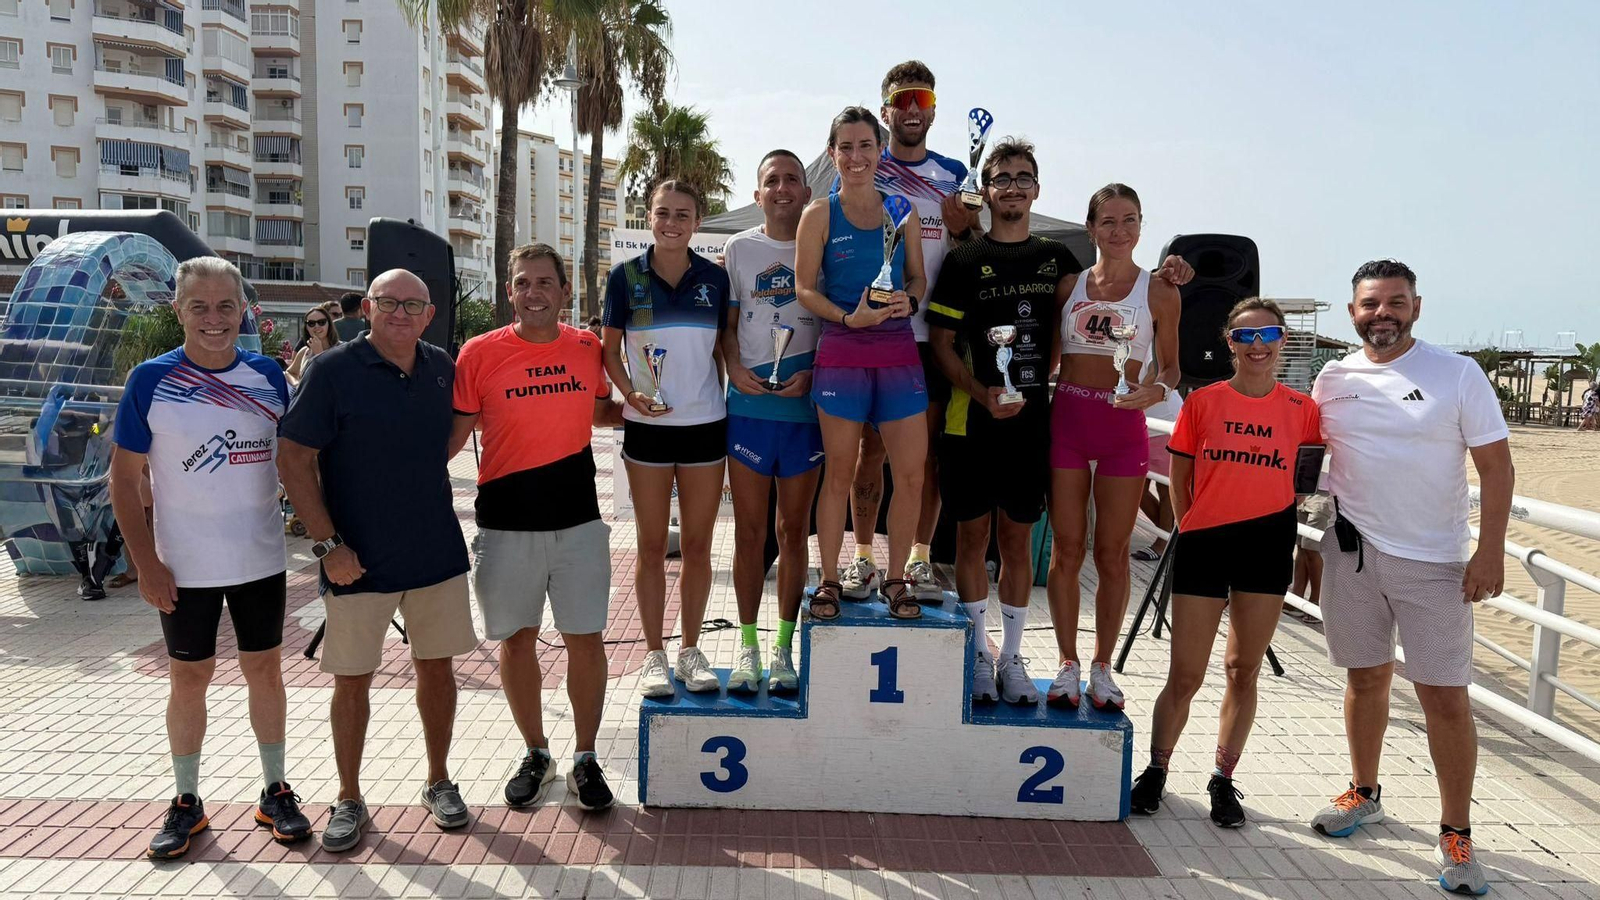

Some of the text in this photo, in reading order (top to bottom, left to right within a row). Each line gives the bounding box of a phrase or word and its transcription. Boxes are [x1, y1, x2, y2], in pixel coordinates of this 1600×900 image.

[919, 216, 942, 227] chip
[771, 276, 792, 288] 5K
[1003, 285, 1017, 296] LA
[1019, 283, 1055, 294] BARROS
[750, 288, 796, 299] Valdelagr
[1085, 315, 1111, 336] 44
[525, 364, 566, 378] TEAM
[1021, 370, 1034, 379] FCS
[505, 375, 587, 400] runnink.
[1223, 421, 1273, 438] TEAM
[181, 443, 208, 472] Jerez
[740, 446, 762, 463] HYGGE
[1203, 448, 1287, 471] runnink.
[869, 646, 904, 703] 1
[700, 735, 748, 792] 3
[1017, 746, 1066, 804] 2
